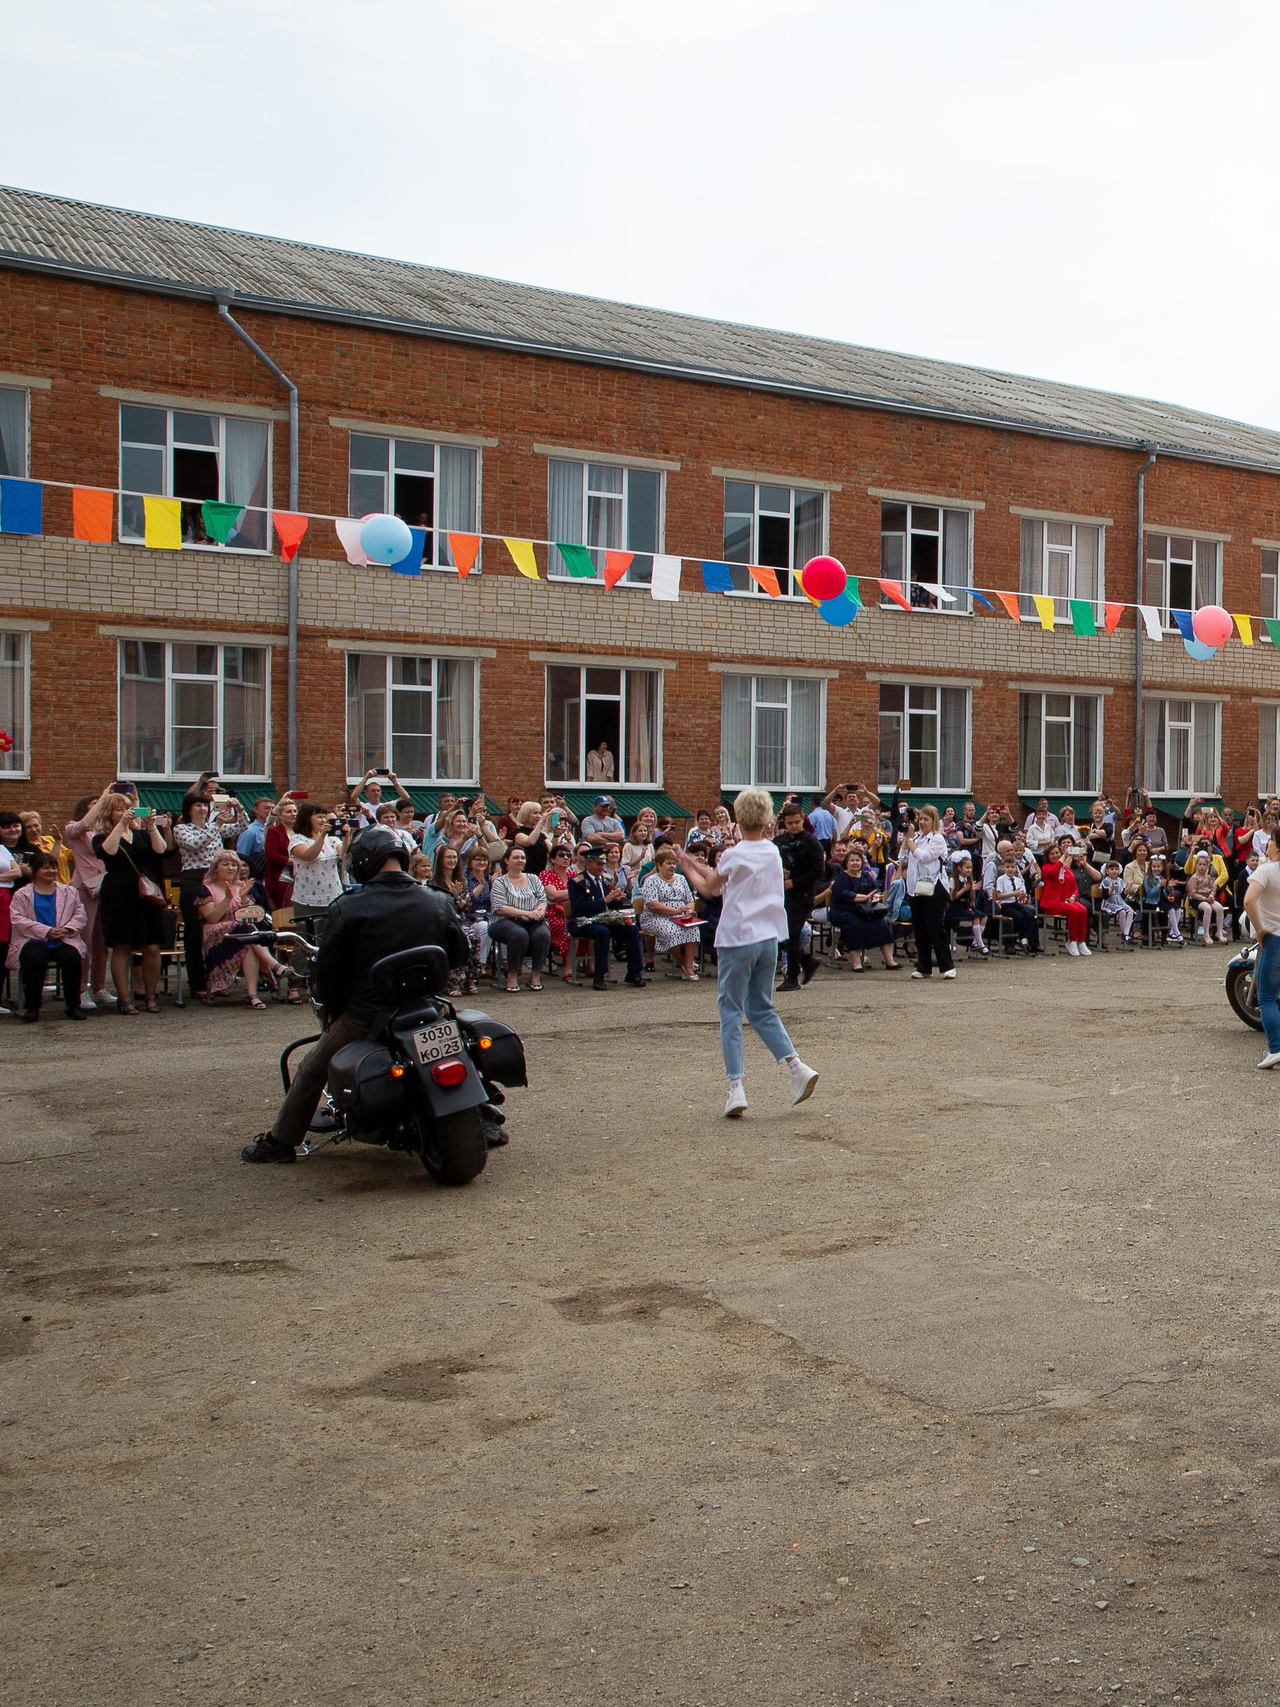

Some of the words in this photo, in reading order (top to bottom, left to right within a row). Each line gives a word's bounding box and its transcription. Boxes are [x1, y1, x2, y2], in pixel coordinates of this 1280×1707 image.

[419, 1025, 452, 1044] 3030
[420, 1047, 440, 1062] КО
[443, 1040, 460, 1055] 23
